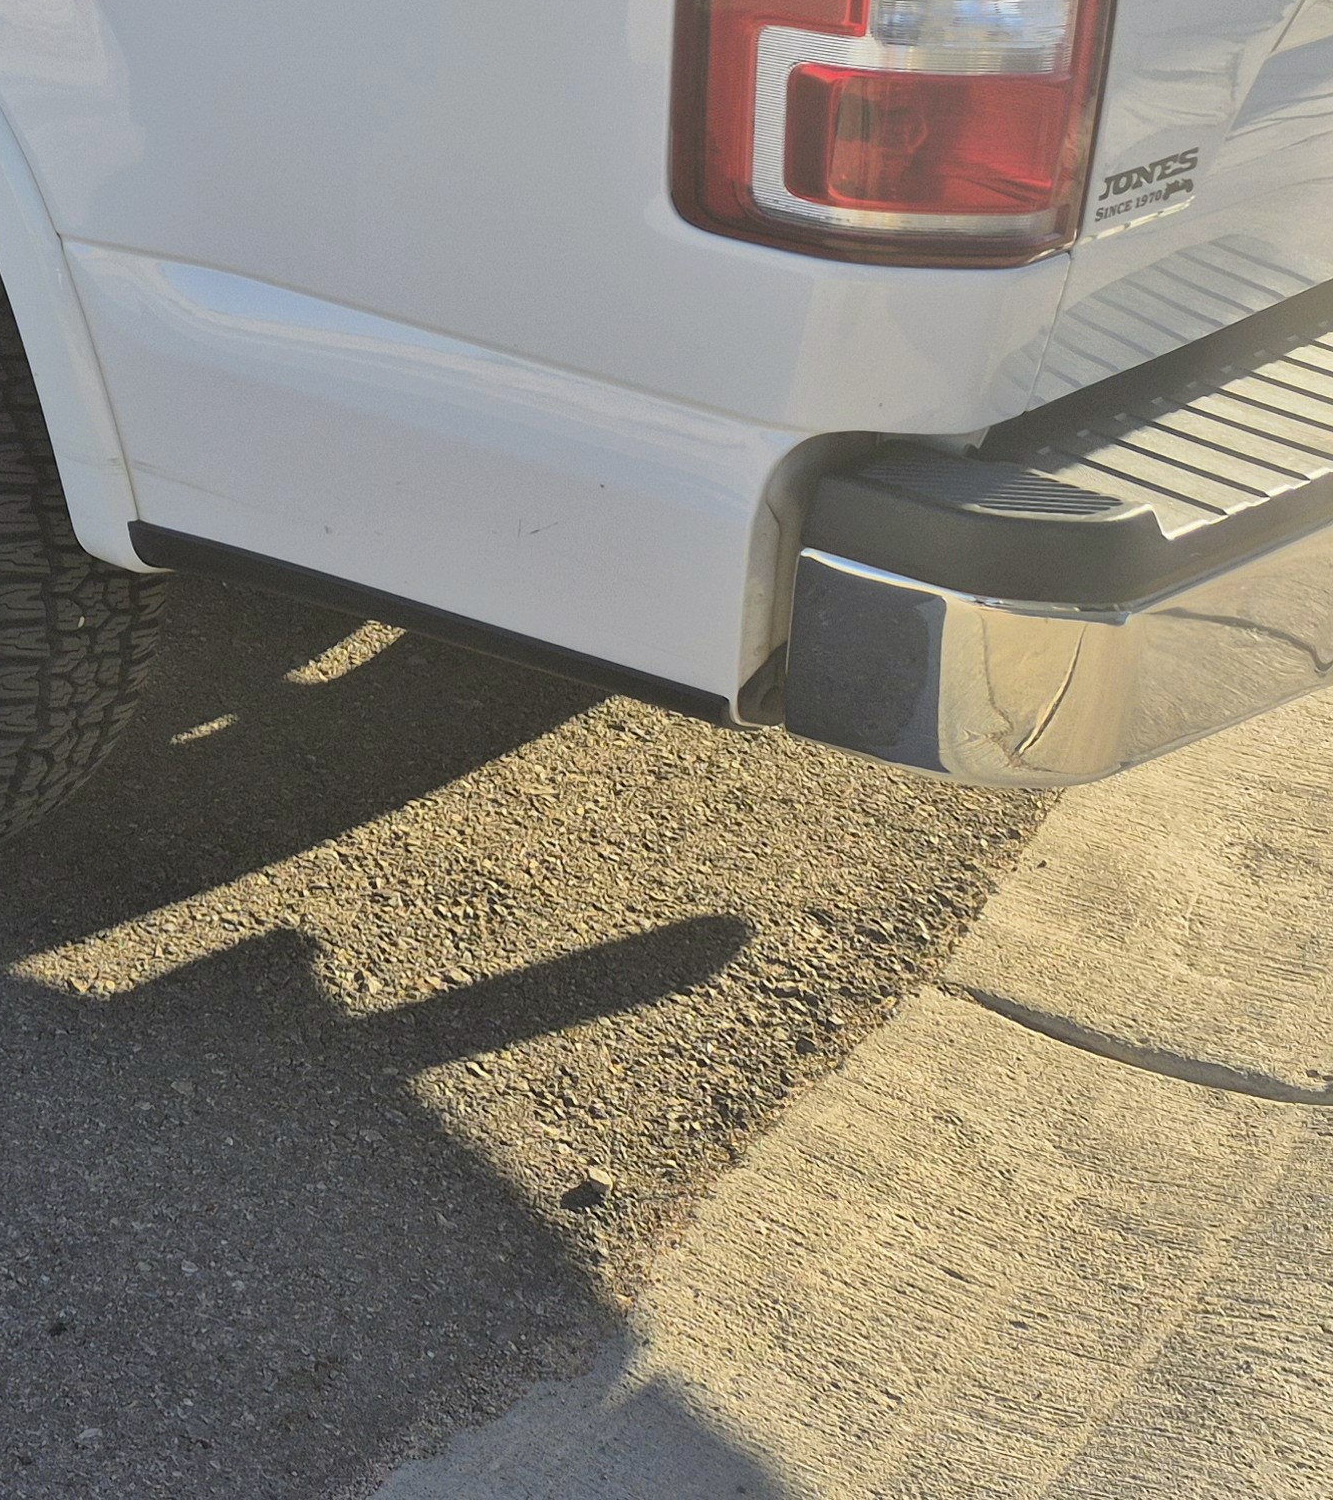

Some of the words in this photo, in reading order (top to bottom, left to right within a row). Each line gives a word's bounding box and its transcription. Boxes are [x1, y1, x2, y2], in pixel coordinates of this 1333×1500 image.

[1099, 147, 1199, 201] JONES
[1094, 199, 1132, 222] SINCE
[1135, 189, 1162, 209] 1970
